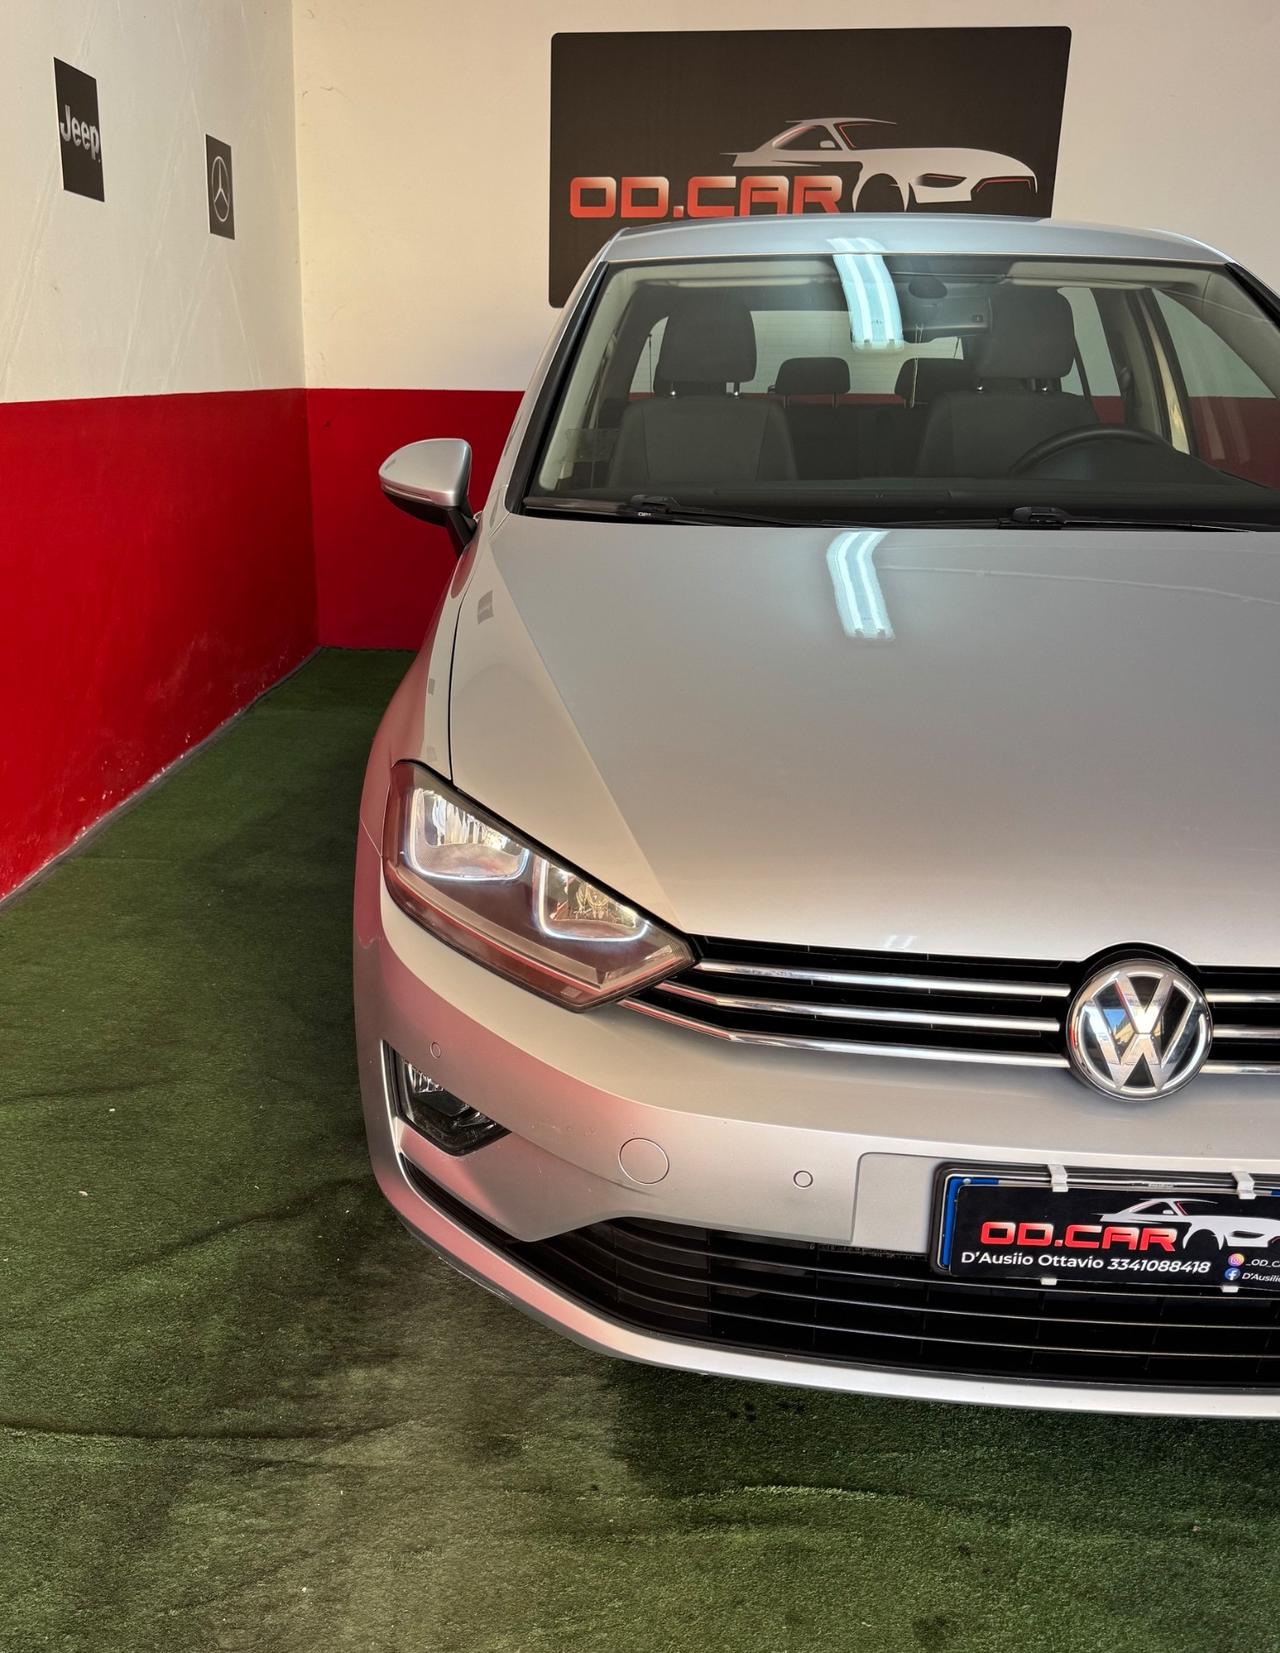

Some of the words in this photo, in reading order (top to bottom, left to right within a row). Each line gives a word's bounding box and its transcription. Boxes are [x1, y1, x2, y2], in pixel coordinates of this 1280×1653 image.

[60, 104, 100, 161] Jeep
[570, 175, 843, 219] OD.CAR
[980, 1221, 1178, 1252] OD.CAR
[1037, 1254, 1104, 1269] Ottavio
[1106, 1257, 1212, 1274] 3341088418
